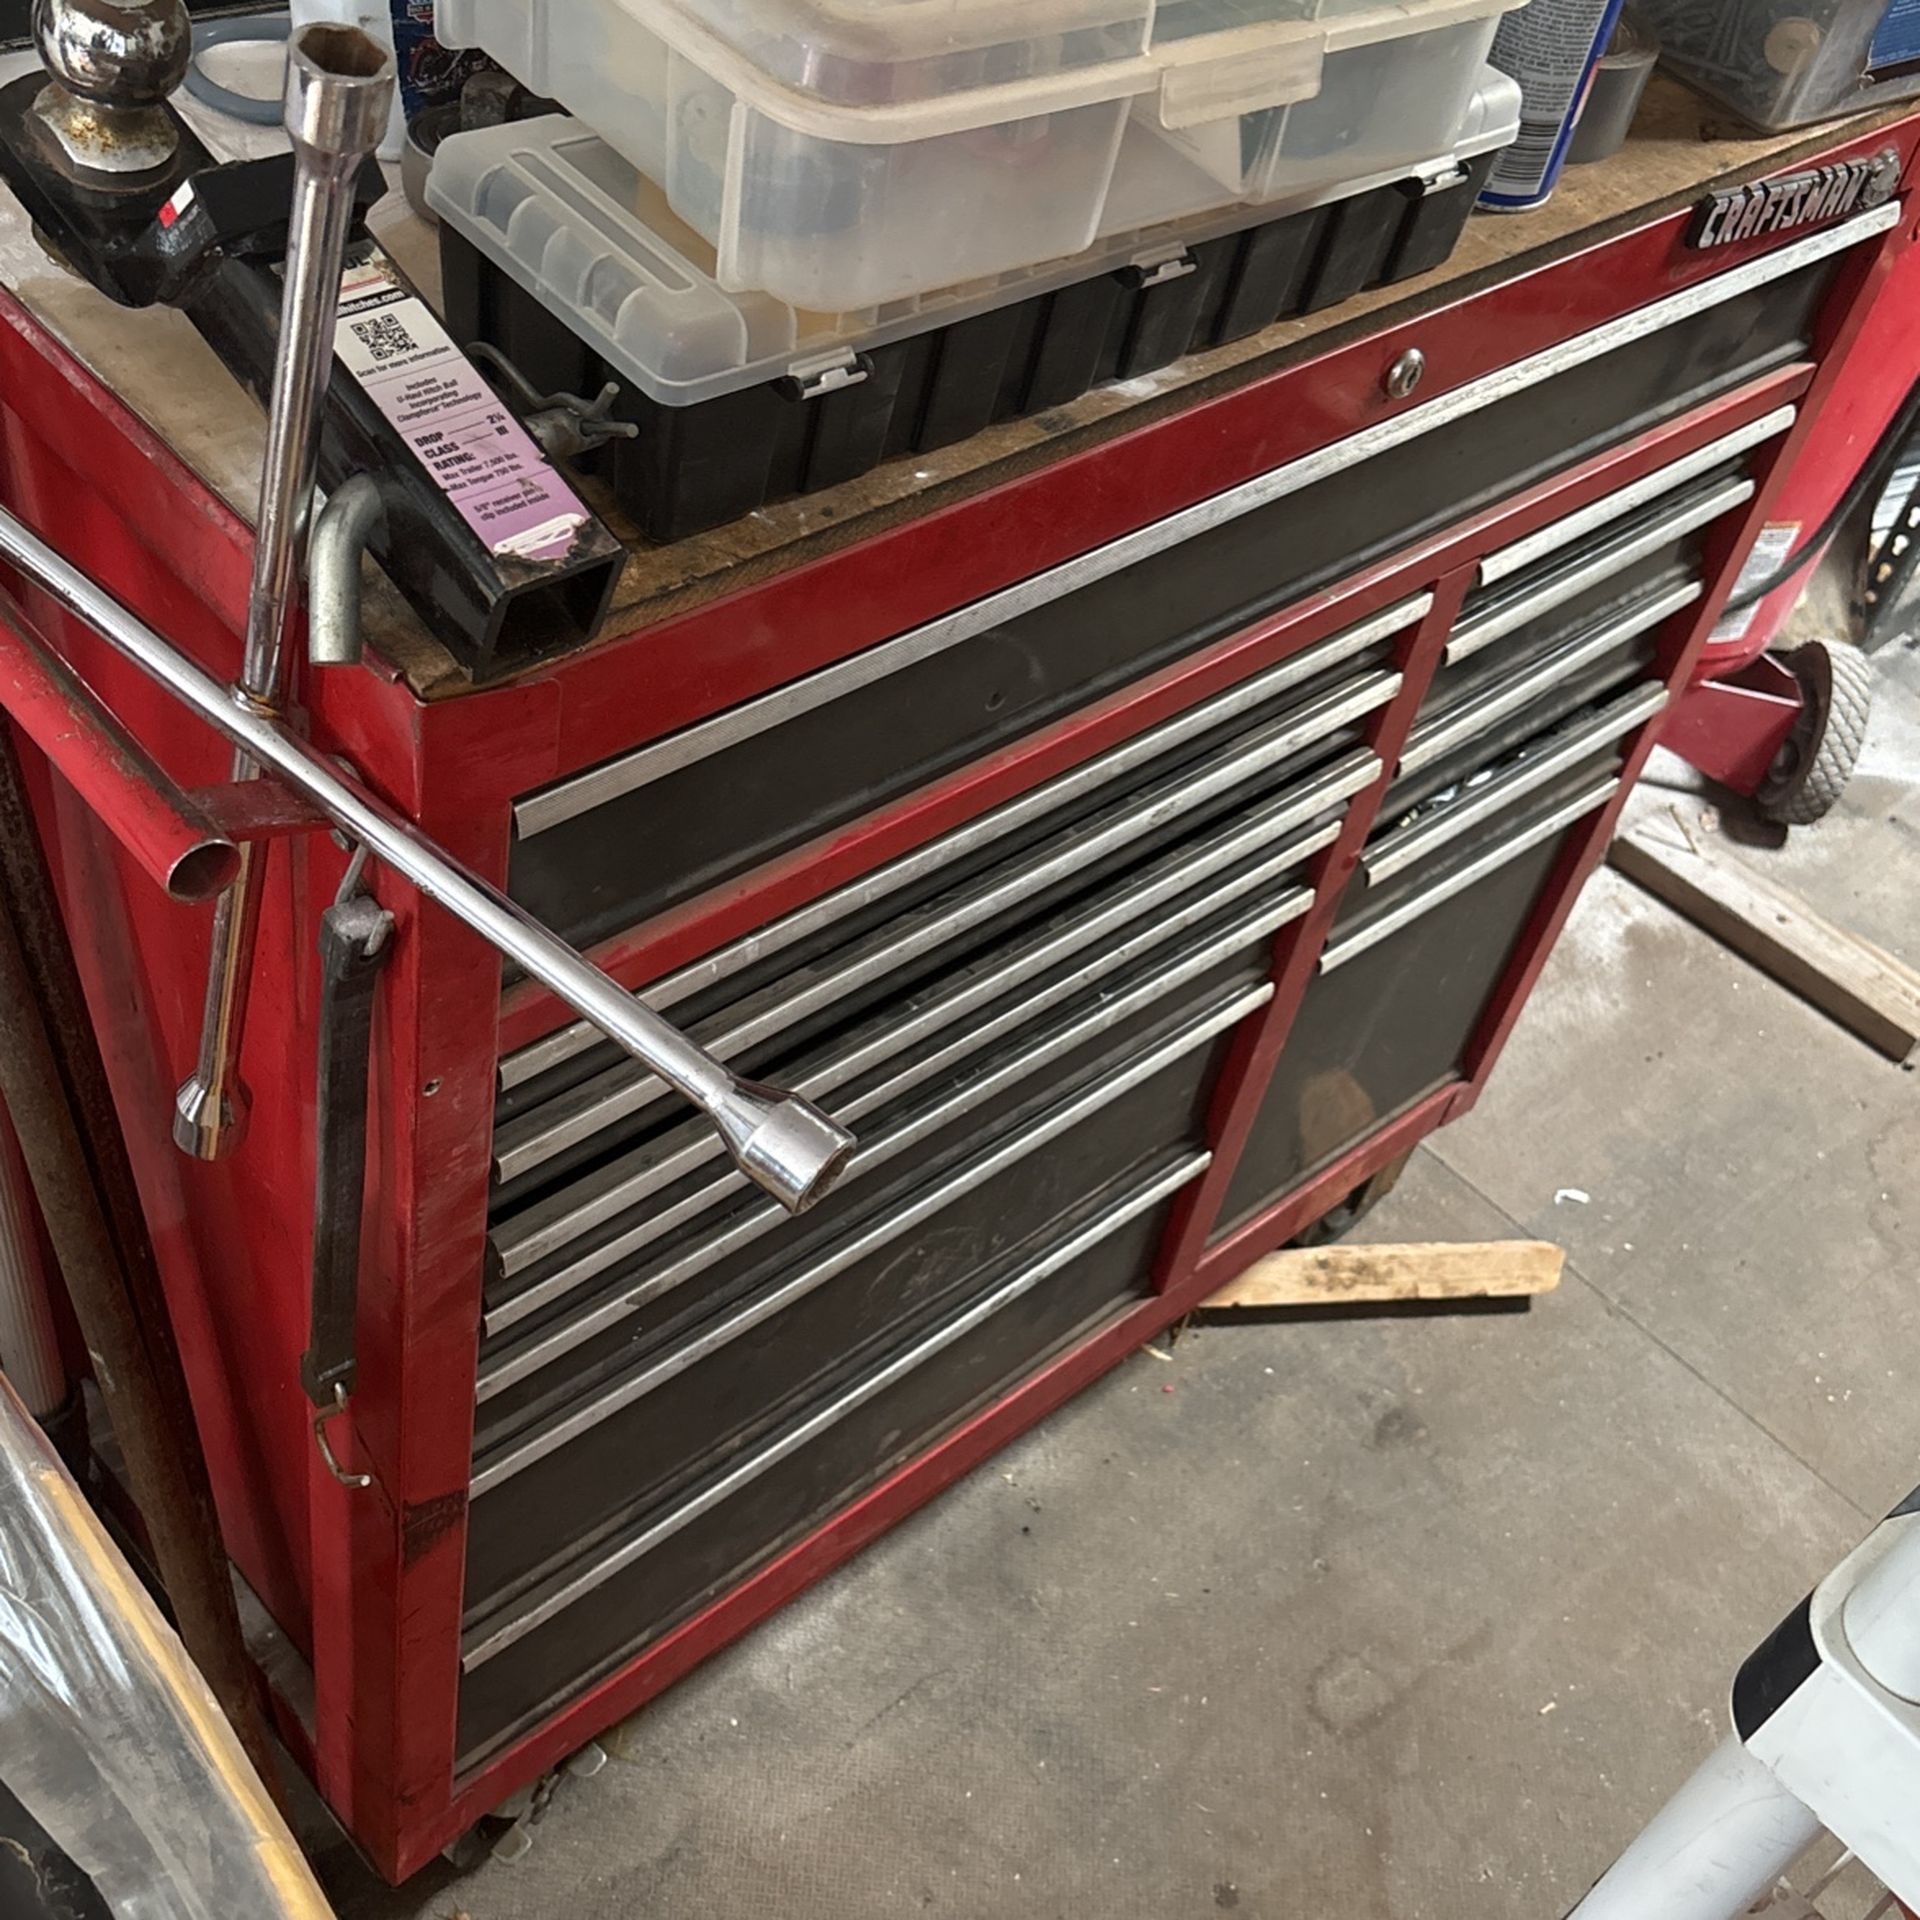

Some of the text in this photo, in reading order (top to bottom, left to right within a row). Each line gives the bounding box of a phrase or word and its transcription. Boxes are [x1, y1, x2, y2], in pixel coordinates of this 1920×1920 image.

[1698, 161, 1869, 249] CRAFTSMAN
[356, 345, 452, 378] Scan for more information
[405, 377, 438, 391] Includes
[422, 384, 443, 396] Hitch
[442, 379, 458, 390] Ball
[408, 390, 459, 409] Incorporating
[441, 392, 482, 409] Technology
[414, 431, 444, 447] DROP
[423, 442, 460, 459] CLASS
[432, 452, 477, 471] RATING:
[442, 472, 460, 481] Max
[459, 463, 484, 476] Trailer
[449, 481, 468, 491] Max
[467, 472, 495, 486] Tongue
[491, 493, 522, 507] receiver
[495, 500, 528, 515] included
[527, 493, 551, 505] inside
